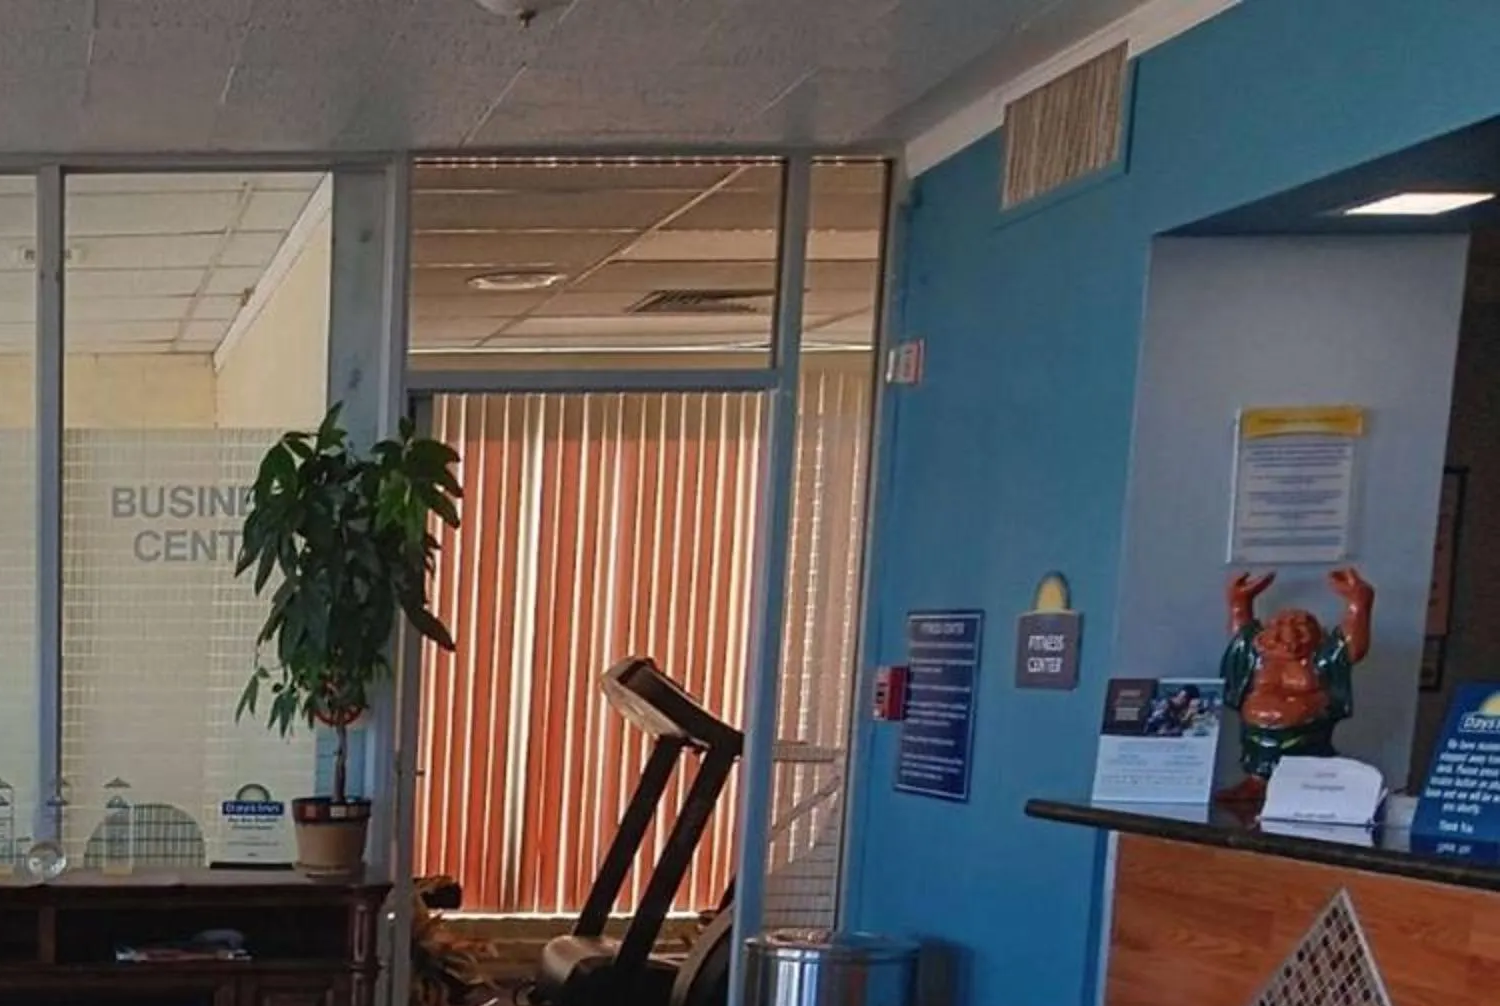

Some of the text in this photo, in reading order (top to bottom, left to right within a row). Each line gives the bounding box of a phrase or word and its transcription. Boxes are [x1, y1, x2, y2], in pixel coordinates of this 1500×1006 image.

[111, 486, 256, 519] BUSINE
[133, 530, 243, 562] CENT
[1027, 634, 1064, 652] FITNESS
[1027, 656, 1062, 673] CENTER
